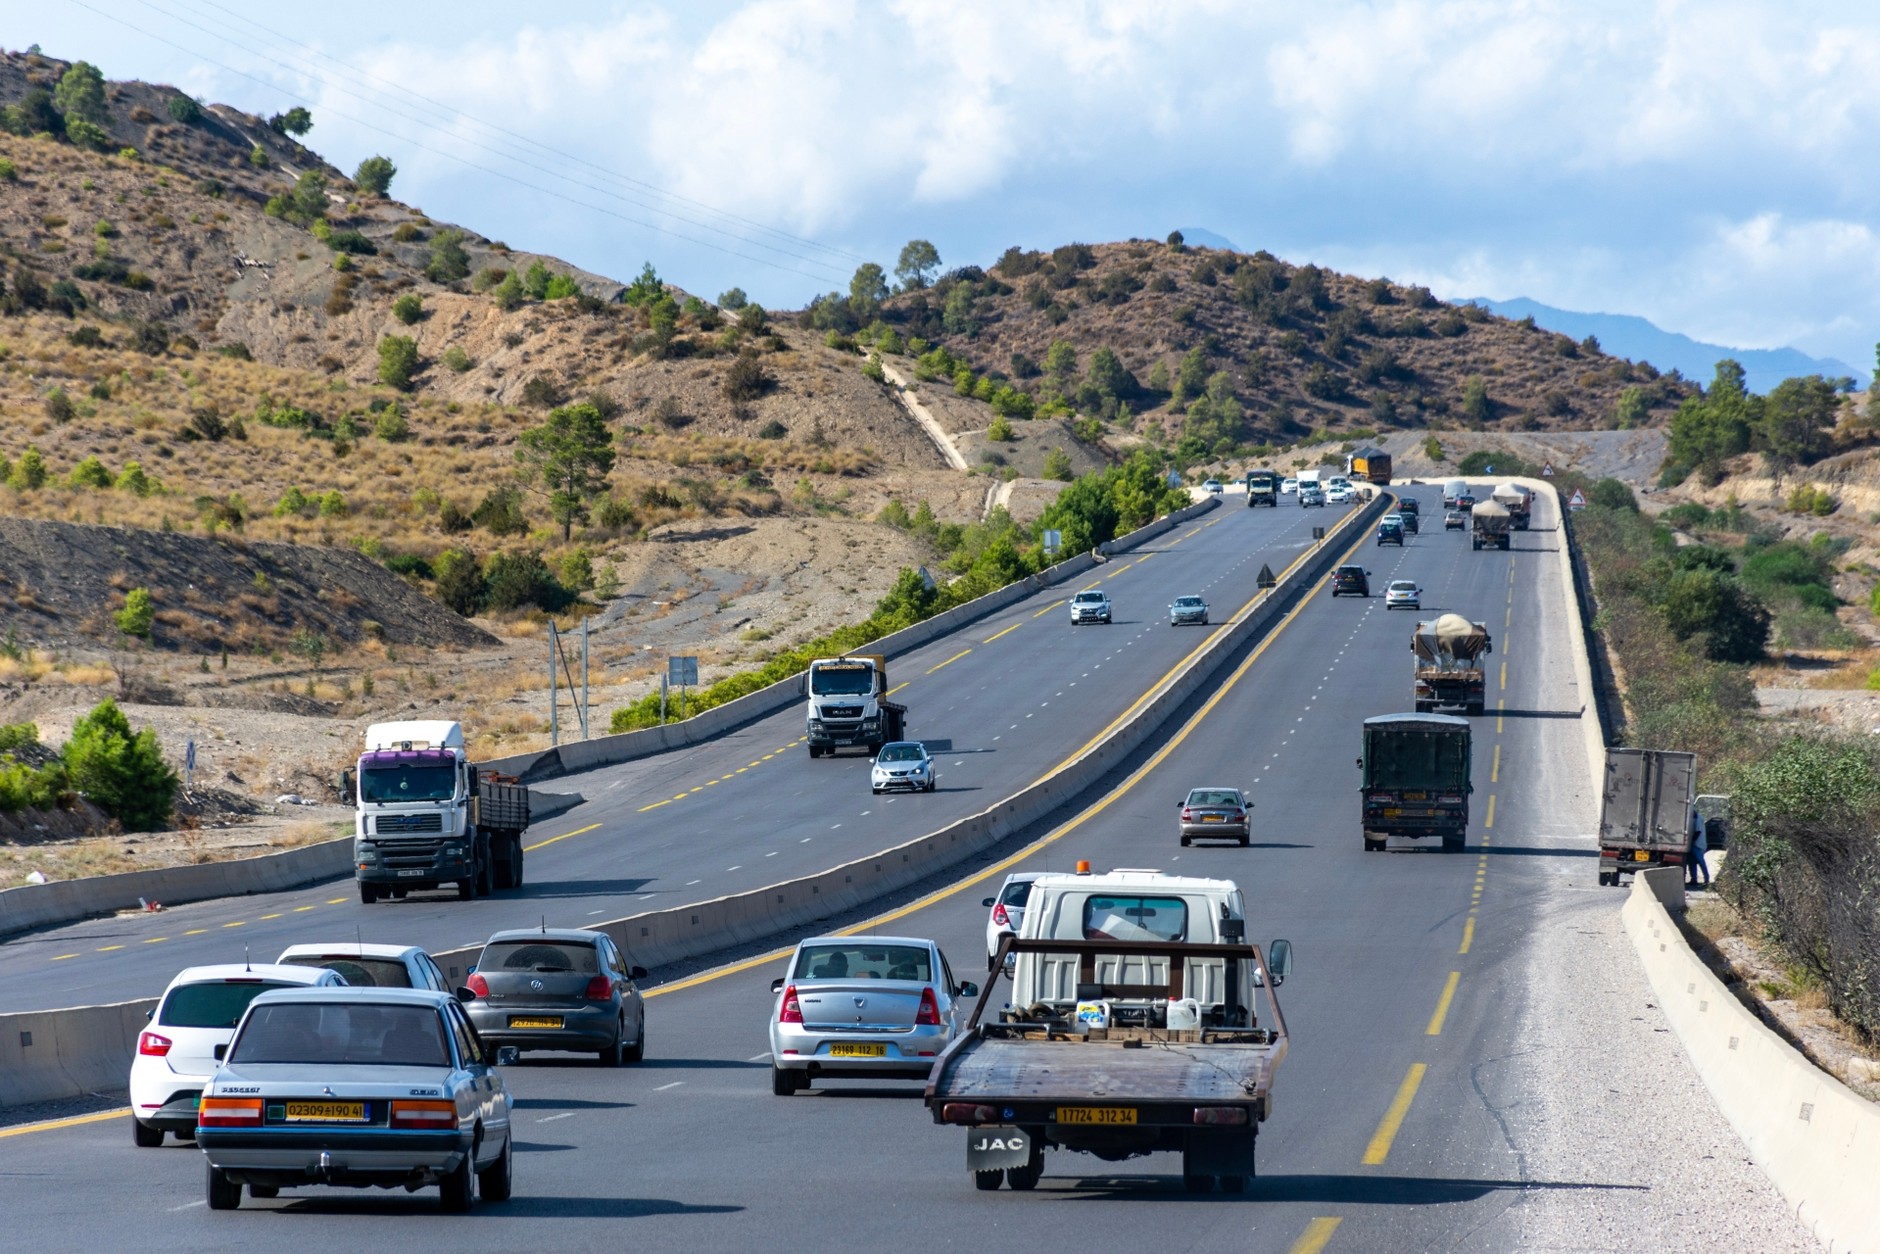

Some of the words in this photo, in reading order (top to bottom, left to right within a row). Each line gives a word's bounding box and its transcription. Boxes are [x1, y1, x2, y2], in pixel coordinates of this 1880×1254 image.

[402, 741, 411, 750] D
[832, 1045, 854, 1055] 23169
[859, 1045, 871, 1055] 112
[876, 1046, 884, 1055] 16
[289, 1105, 324, 1116] 02309
[352, 1106, 362, 1116] 41
[1063, 1109, 1092, 1122] 17724
[1098, 1109, 1117, 1122] 312
[1120, 1110, 1132, 1122] 34
[973, 1138, 1023, 1151] JAC
